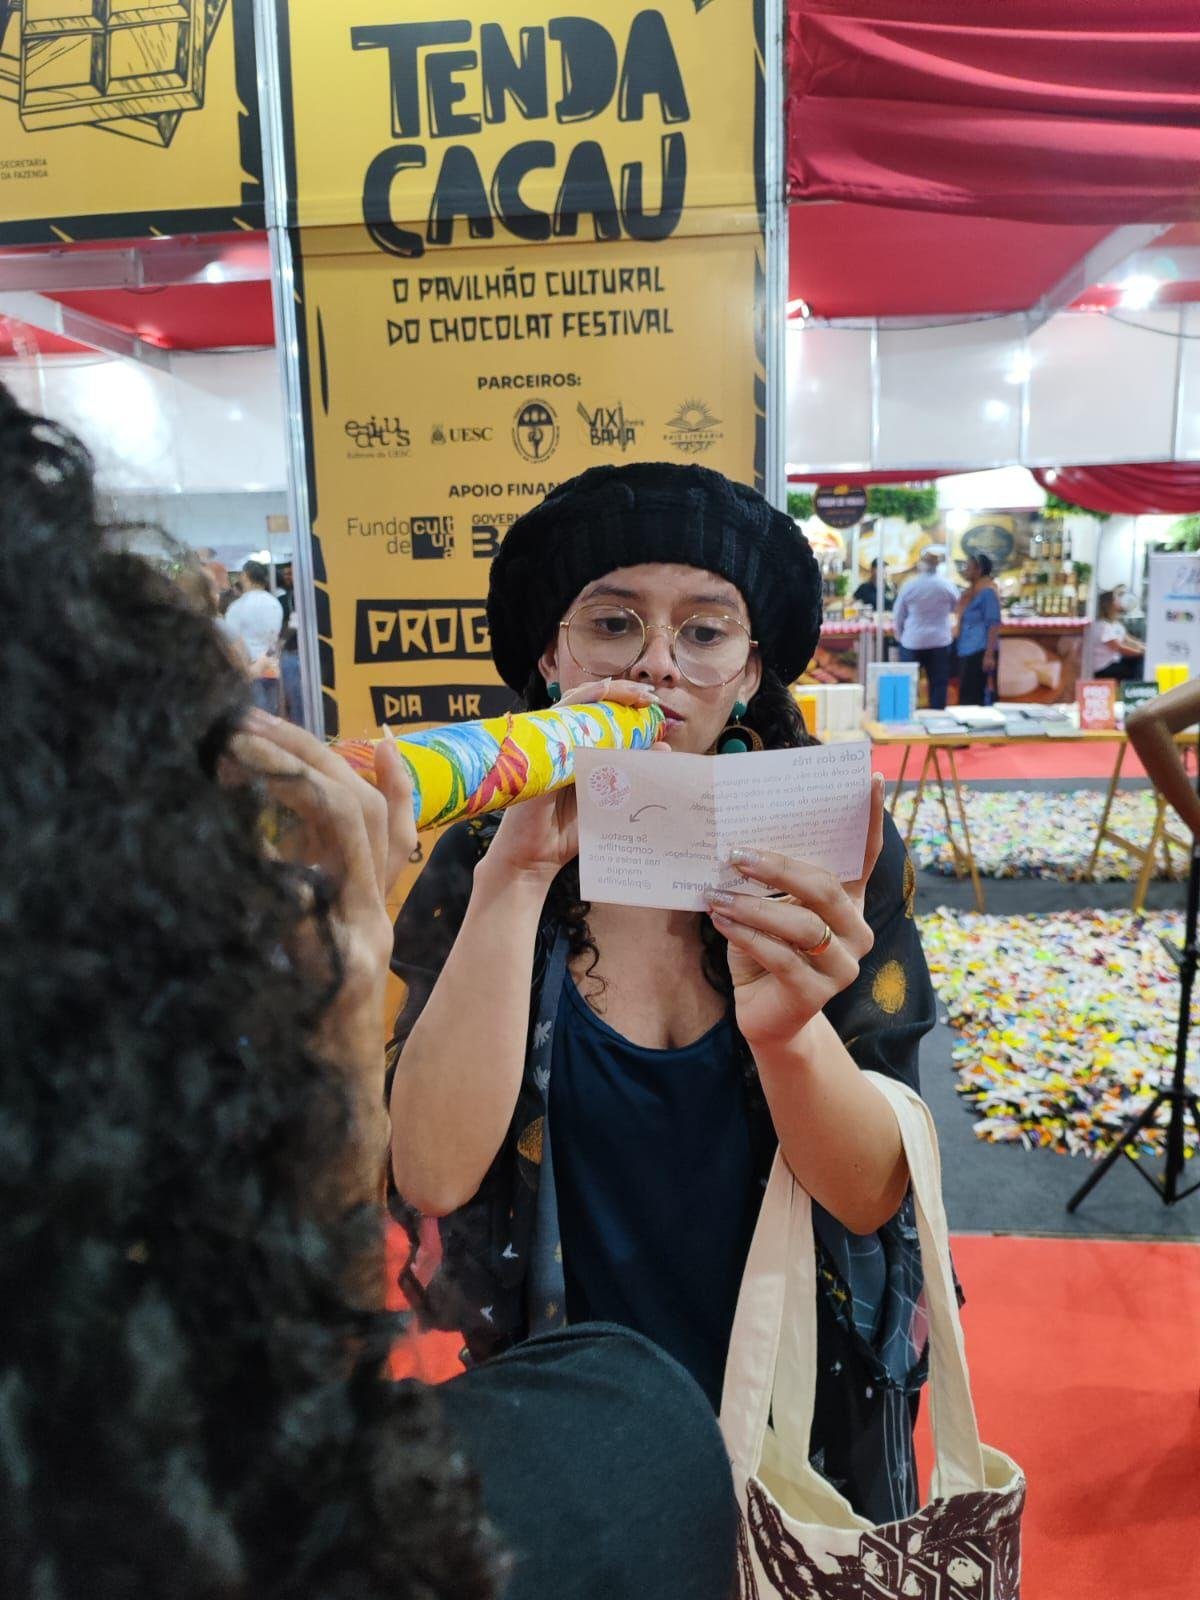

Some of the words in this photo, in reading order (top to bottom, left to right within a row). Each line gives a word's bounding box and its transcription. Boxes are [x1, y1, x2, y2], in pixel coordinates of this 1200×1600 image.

[351, 9, 691, 139] TENDA
[362, 131, 688, 259] CACAU
[392, 278, 409, 303] O
[418, 267, 536, 302] PAVILHÃO
[545, 266, 666, 298] CULTURAL
[387, 318, 421, 346] DO
[430, 313, 553, 343] CHOCOLAT
[563, 307, 675, 339] FESTIVAL
[477, 373, 582, 391] PARCEIROS:
[449, 427, 494, 443] UESC
[449, 484, 503, 498] APOIO
[347, 517, 411, 537] Fundo
[387, 537, 411, 554] de
[368, 608, 492, 655] PROG
[383, 694, 422, 719] DIA
[448, 694, 481, 717] HR
